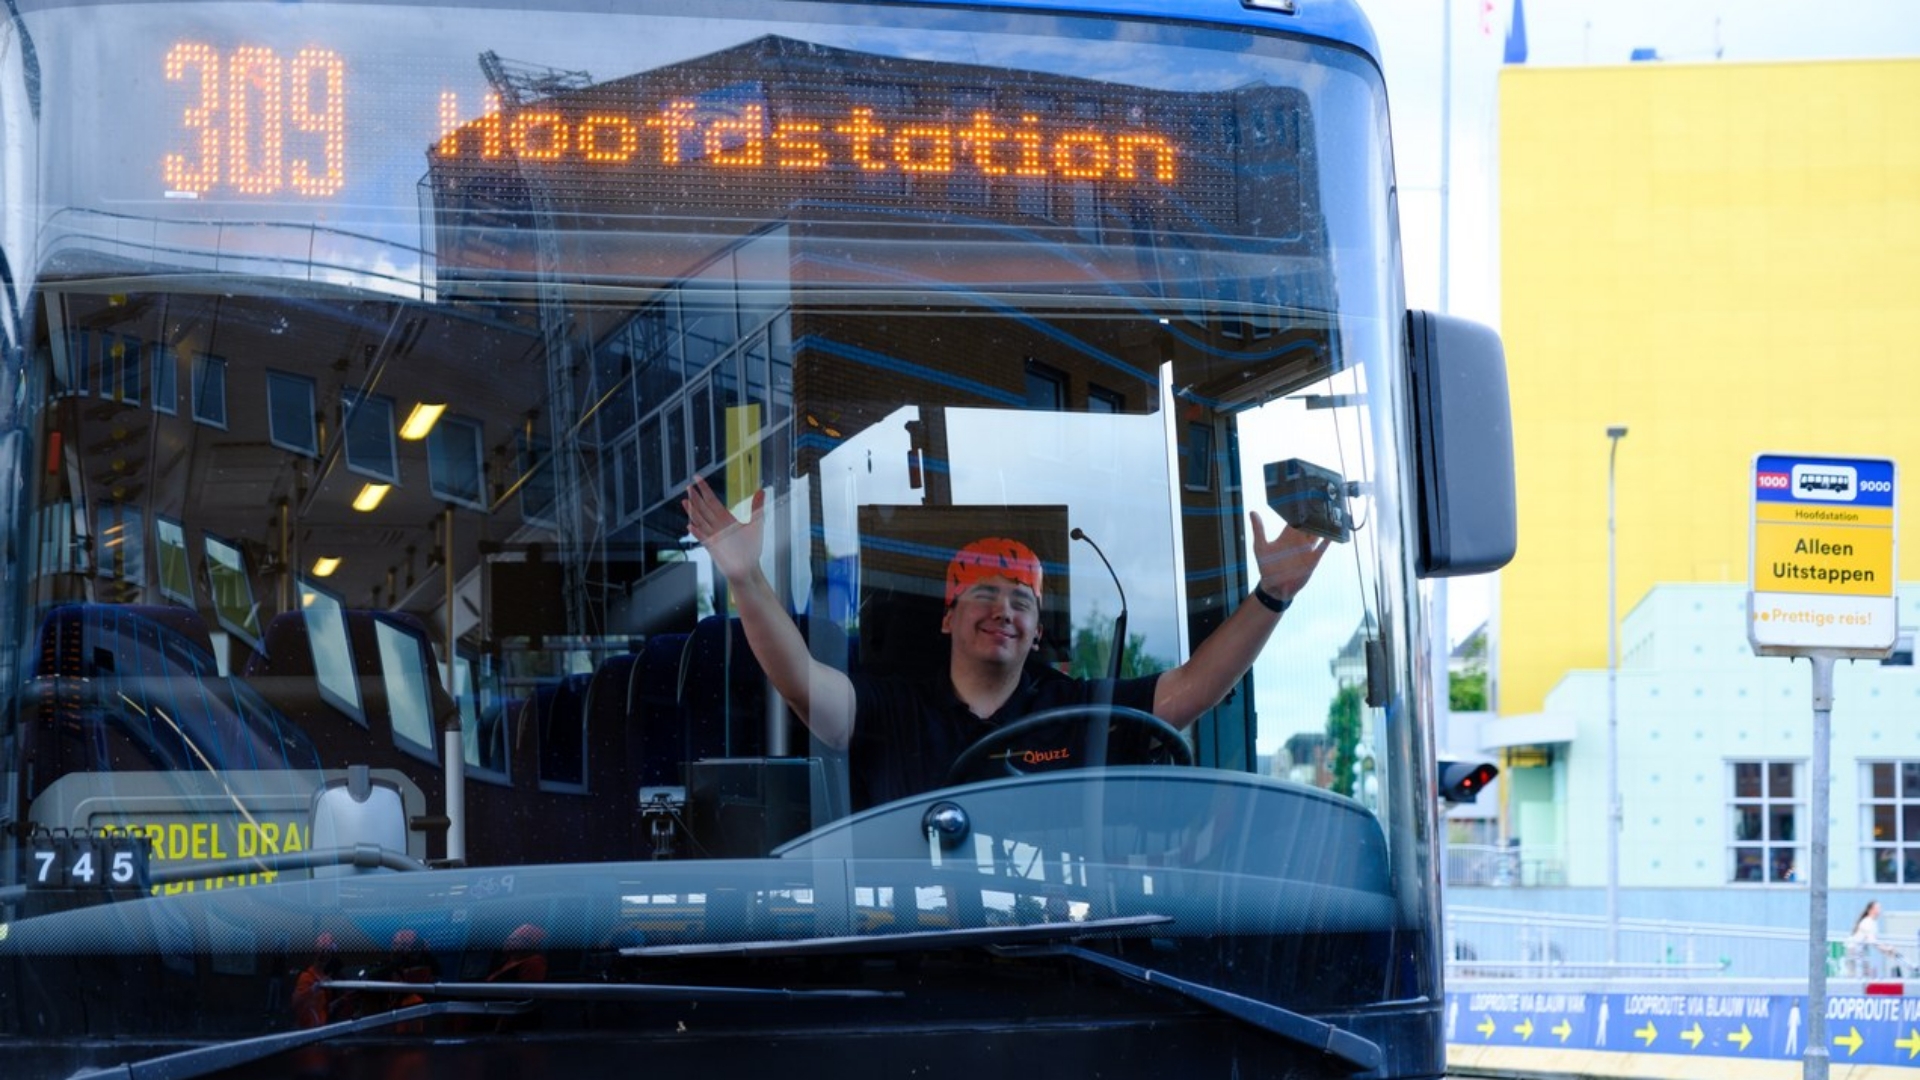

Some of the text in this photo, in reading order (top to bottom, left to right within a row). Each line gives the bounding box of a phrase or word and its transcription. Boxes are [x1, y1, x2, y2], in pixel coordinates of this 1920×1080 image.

[166, 44, 1176, 195] 309 Hoofdstation
[1758, 475, 1891, 493] 1000 9000
[1795, 509, 1859, 522] Hoofdstation
[1795, 537, 1853, 556] Alleen
[1773, 562, 1875, 584] Uitstappen
[1772, 608, 1872, 627] Prettige reis!
[1023, 748, 1069, 764] Qbuzz
[238, 822, 309, 858] DRA
[1625, 995, 1770, 1018] LOOPROUTE VIA BLAUW VAK
